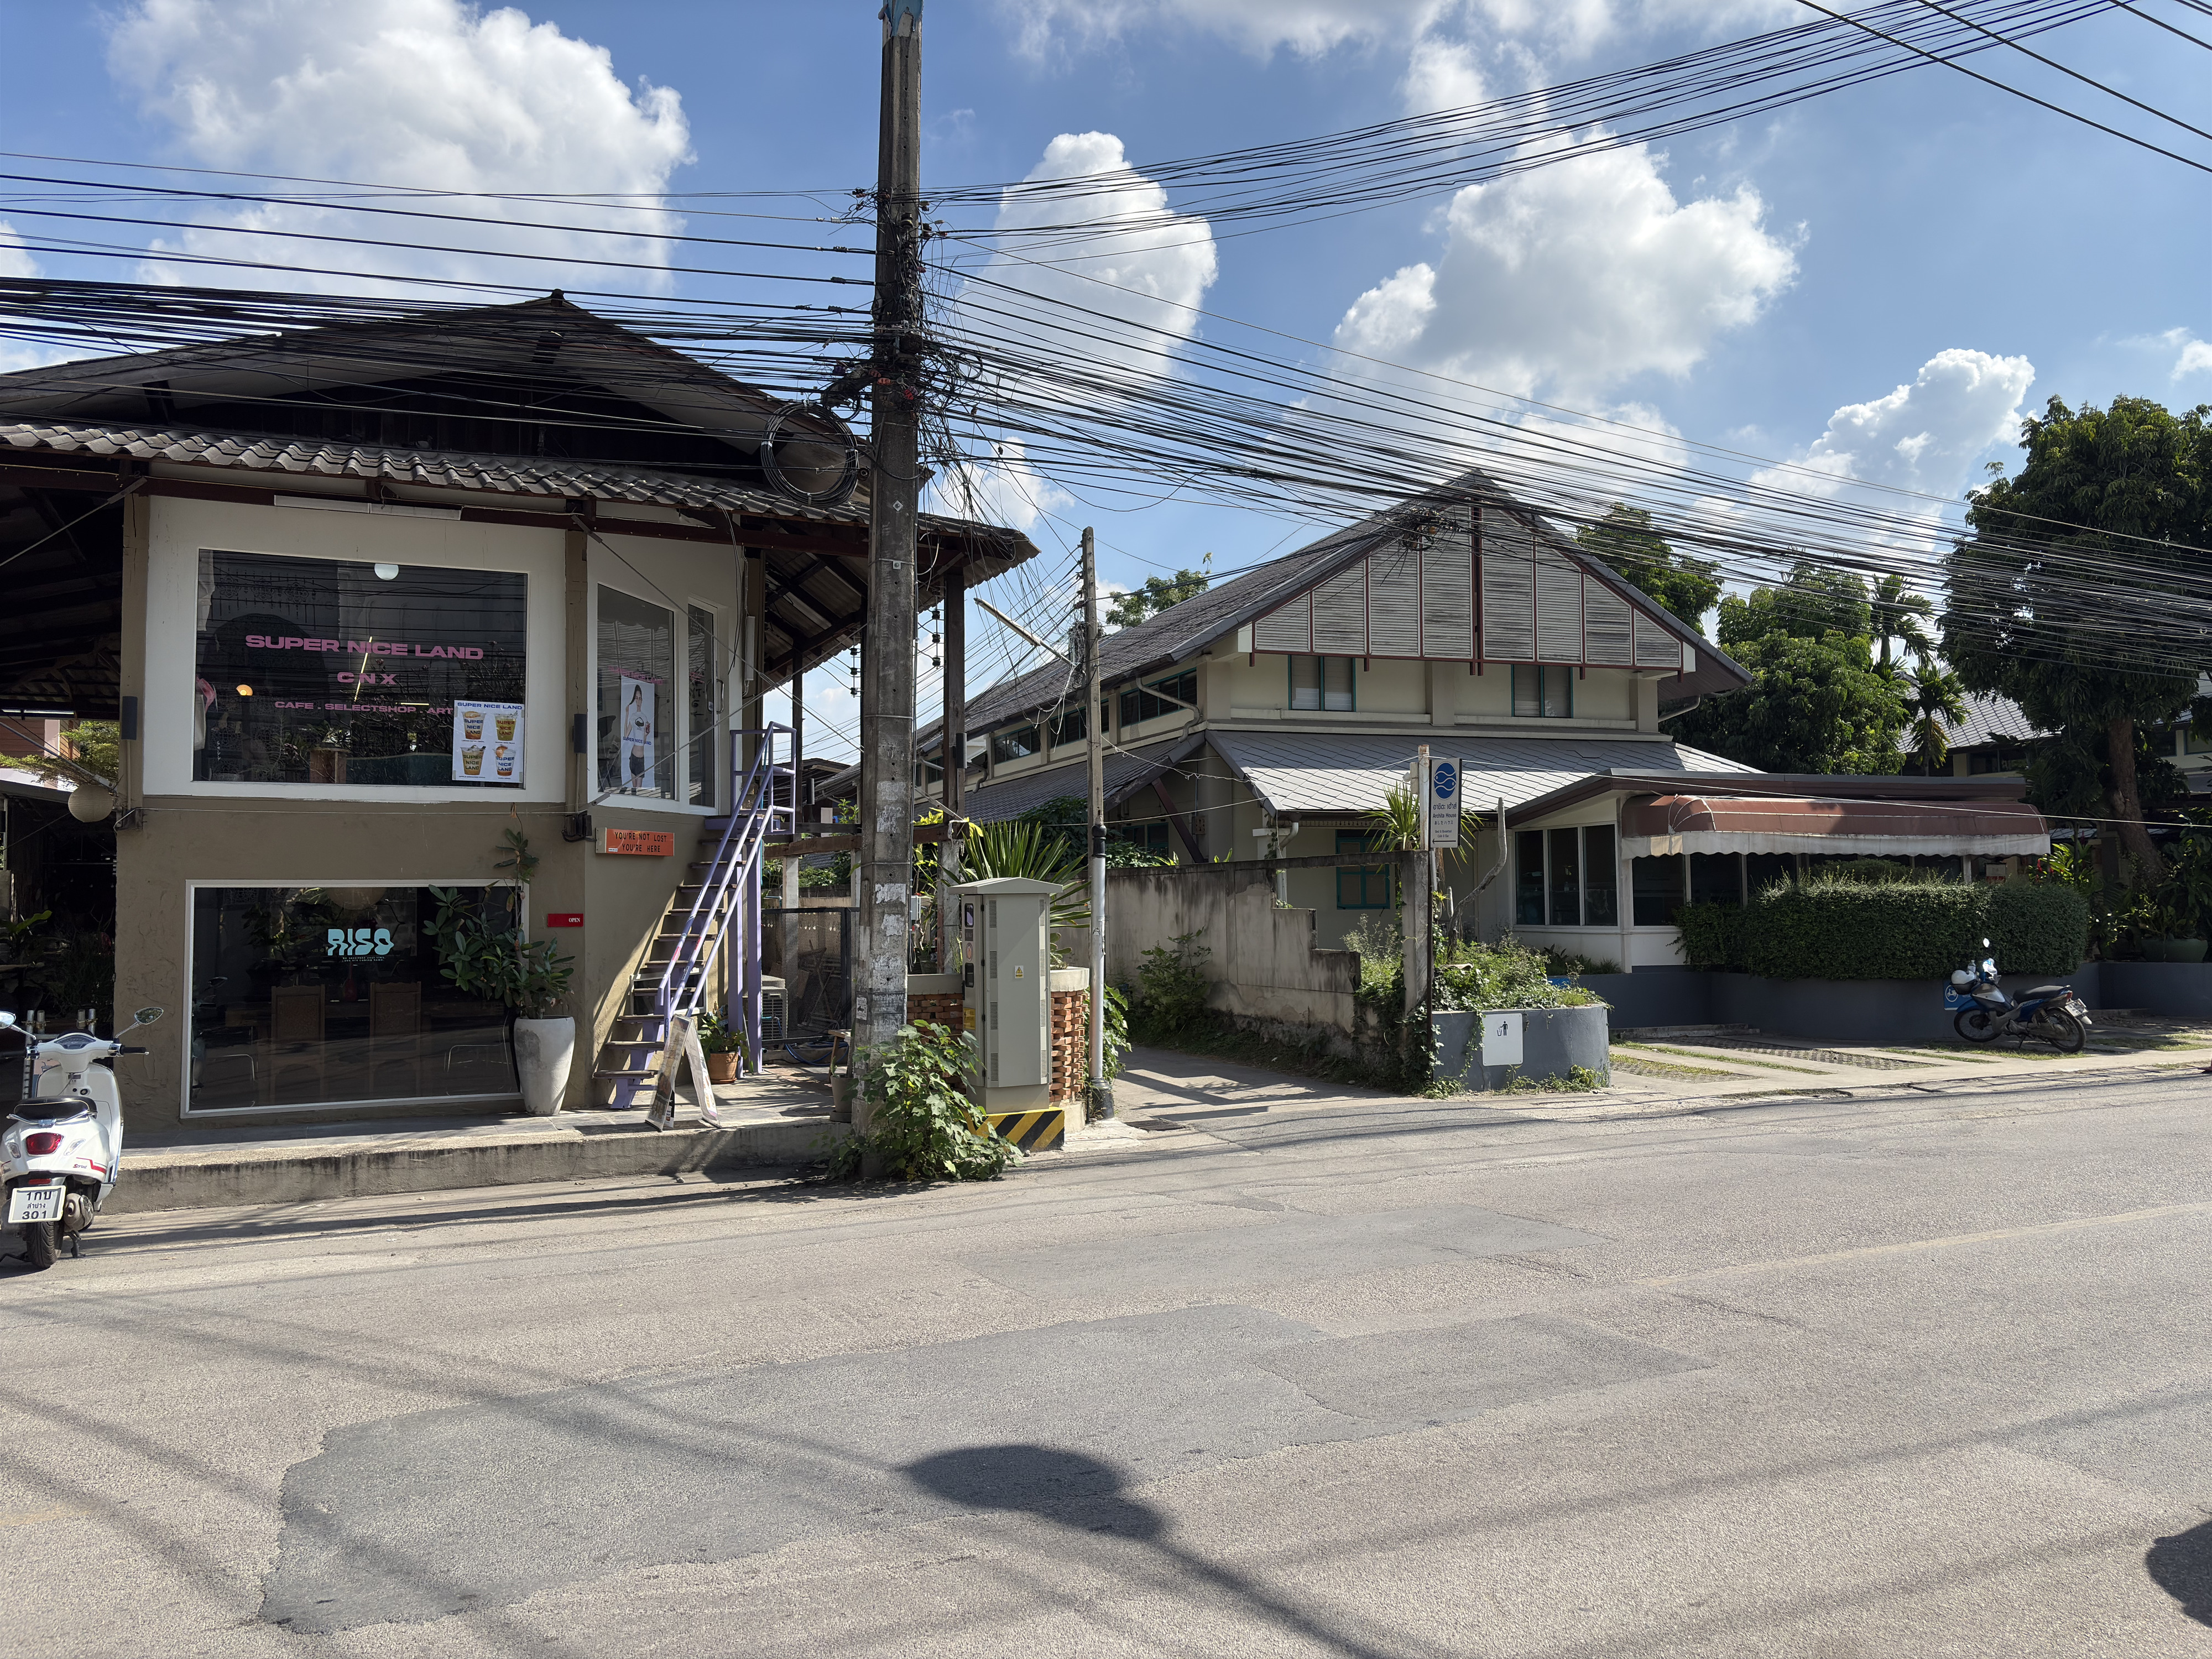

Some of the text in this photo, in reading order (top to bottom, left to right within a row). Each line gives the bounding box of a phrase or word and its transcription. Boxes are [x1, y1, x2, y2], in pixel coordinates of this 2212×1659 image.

[245, 635, 484, 660] SUPER NICE LAND
[337, 671, 397, 685] CNX
[274, 701, 314, 709] CAFE
[325, 703, 416, 713] SELECTSHOP
[614, 832, 635, 840] YOU'RE
[622, 843, 642, 852] YOU'RE
[327, 928, 395, 956] RISO
[22, 1210, 47, 1220] 301
